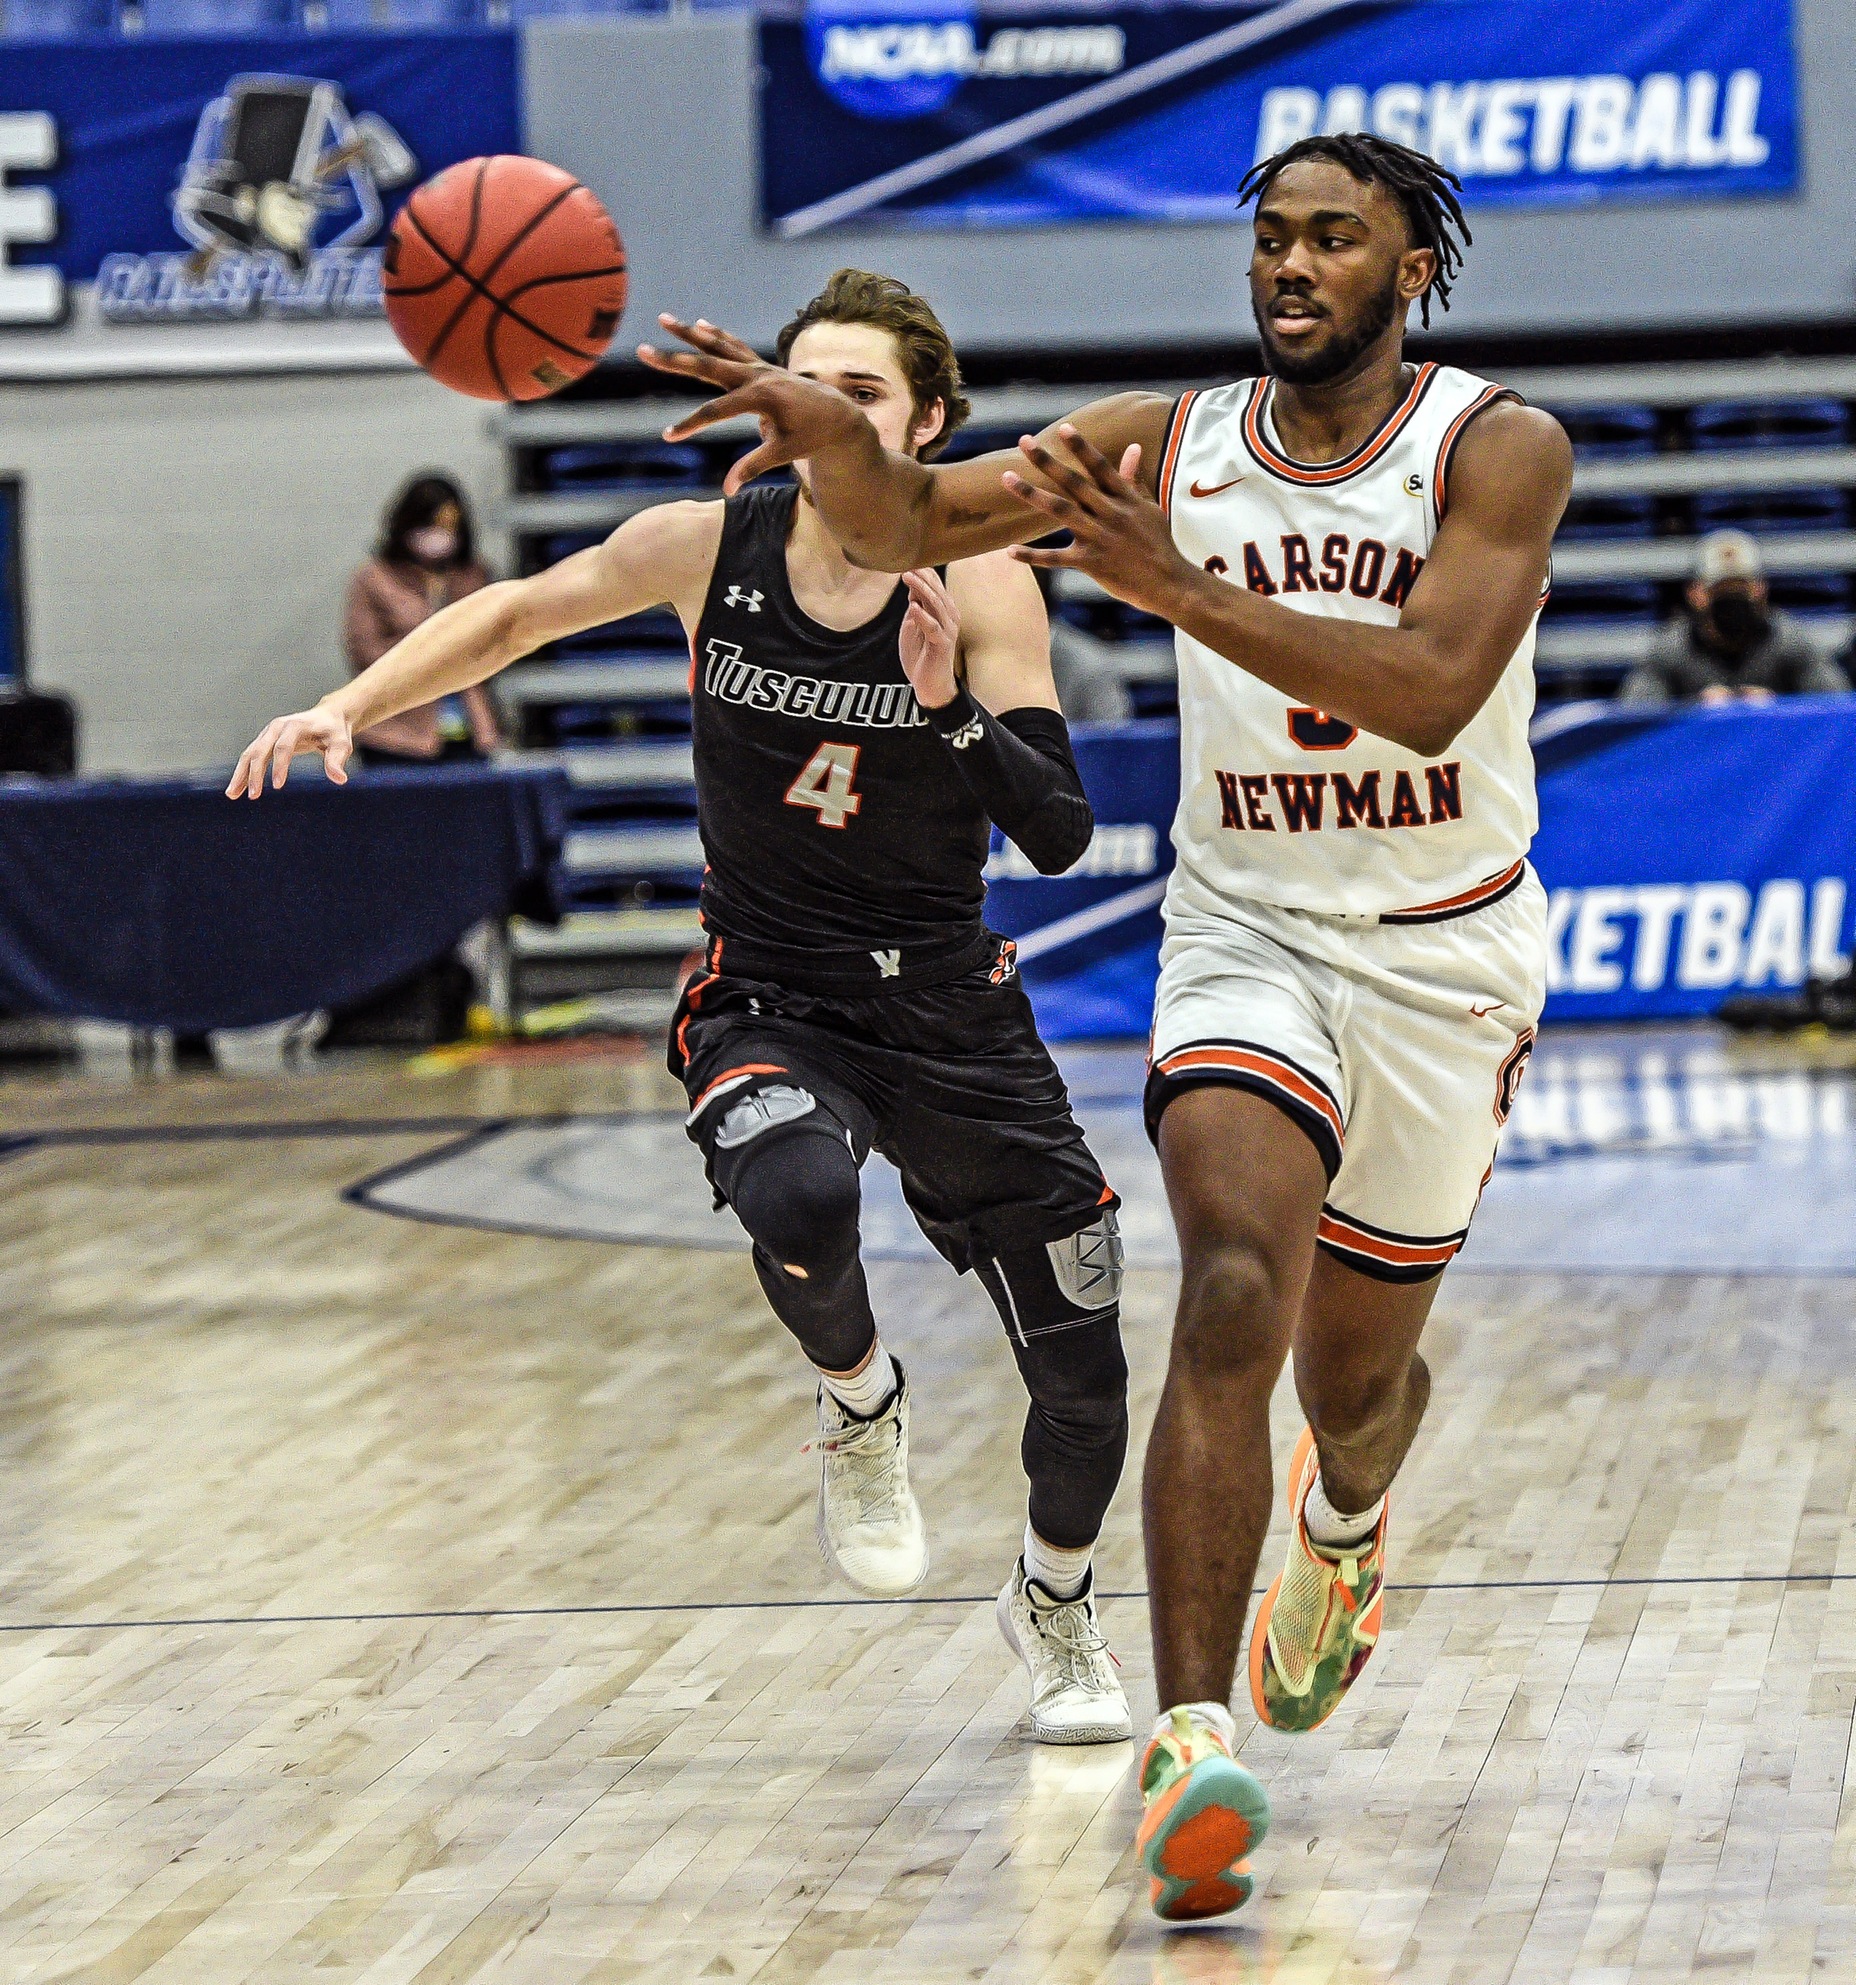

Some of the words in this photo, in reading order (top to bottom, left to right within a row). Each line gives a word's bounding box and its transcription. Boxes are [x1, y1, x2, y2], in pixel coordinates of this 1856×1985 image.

[821, 21, 1126, 80] NCAA.com
[1253, 68, 1772, 180] BASKETBALL
[784, 741, 862, 829] 4
[1214, 761, 1464, 834] NEWMAN
